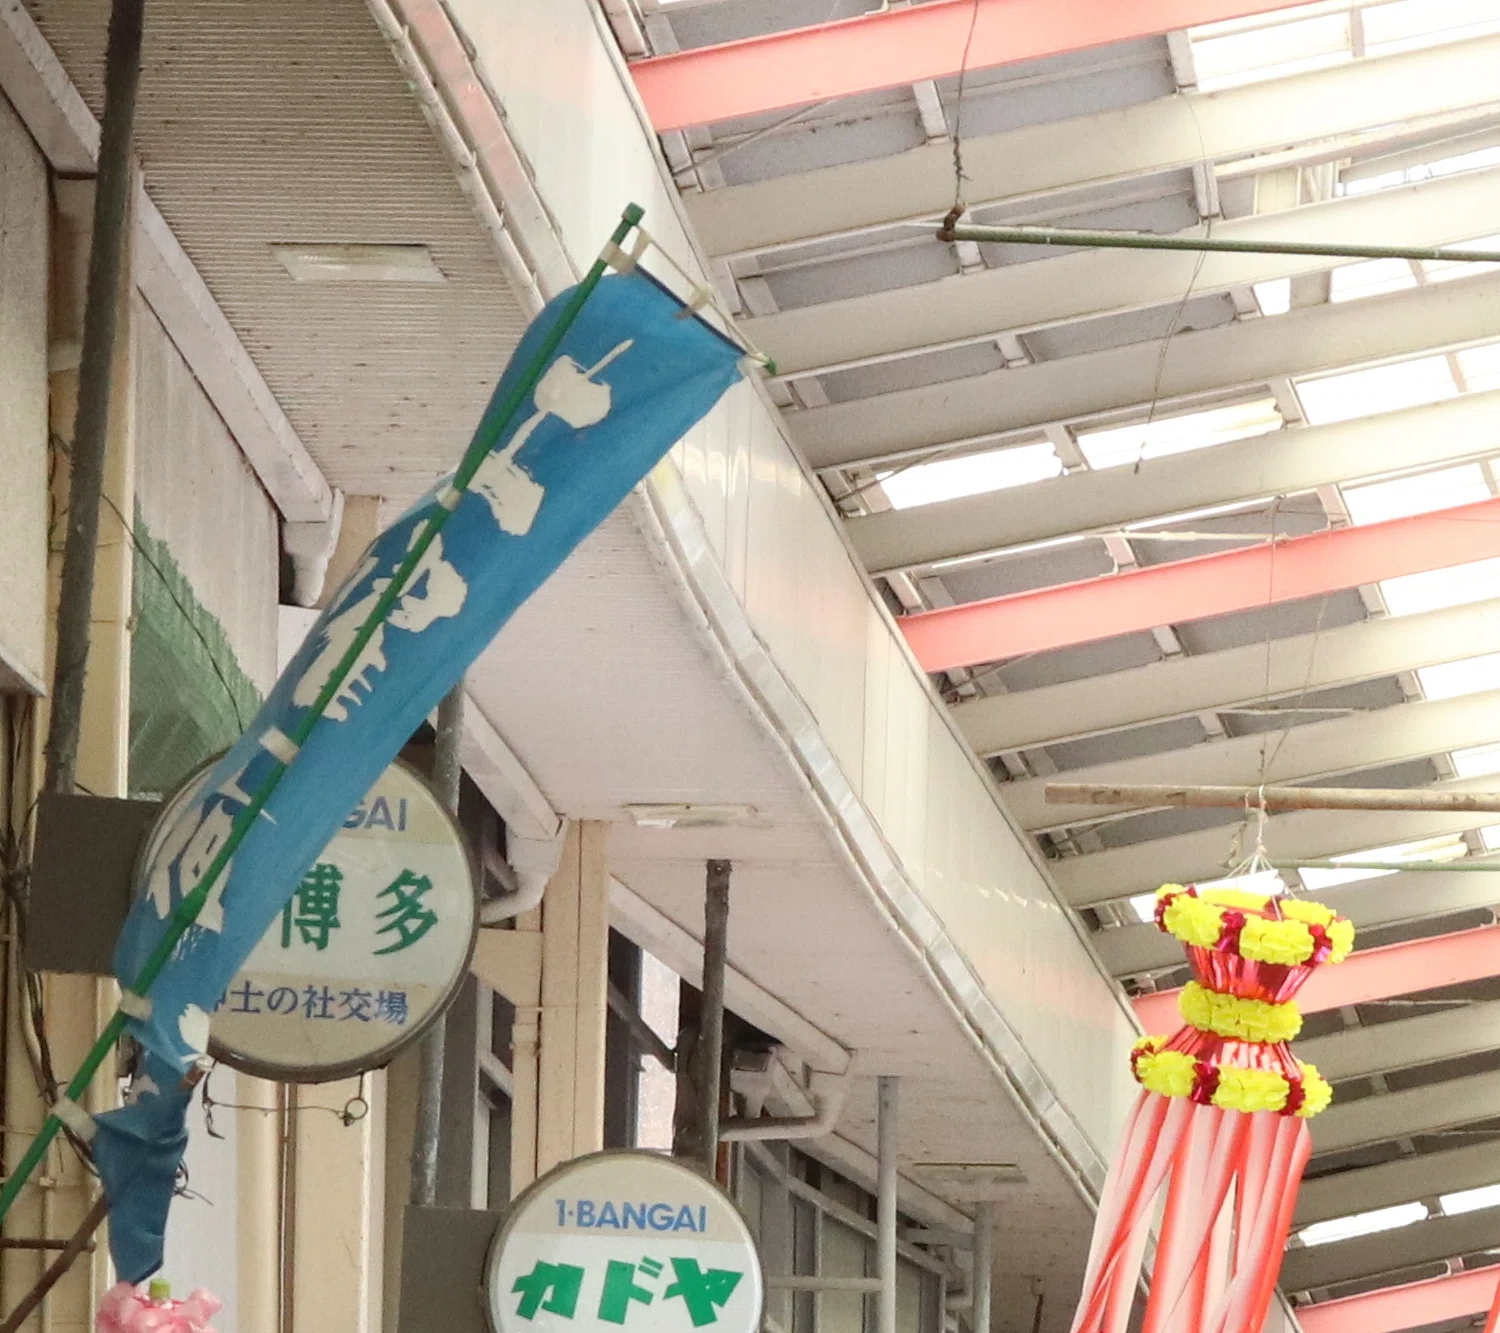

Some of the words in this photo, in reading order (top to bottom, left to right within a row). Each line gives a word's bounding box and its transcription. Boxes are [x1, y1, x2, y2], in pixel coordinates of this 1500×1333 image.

[280, 862, 438, 955] 博多
[213, 980, 409, 1025] 士の社交場
[510, 1255, 745, 1328] カドヤ
